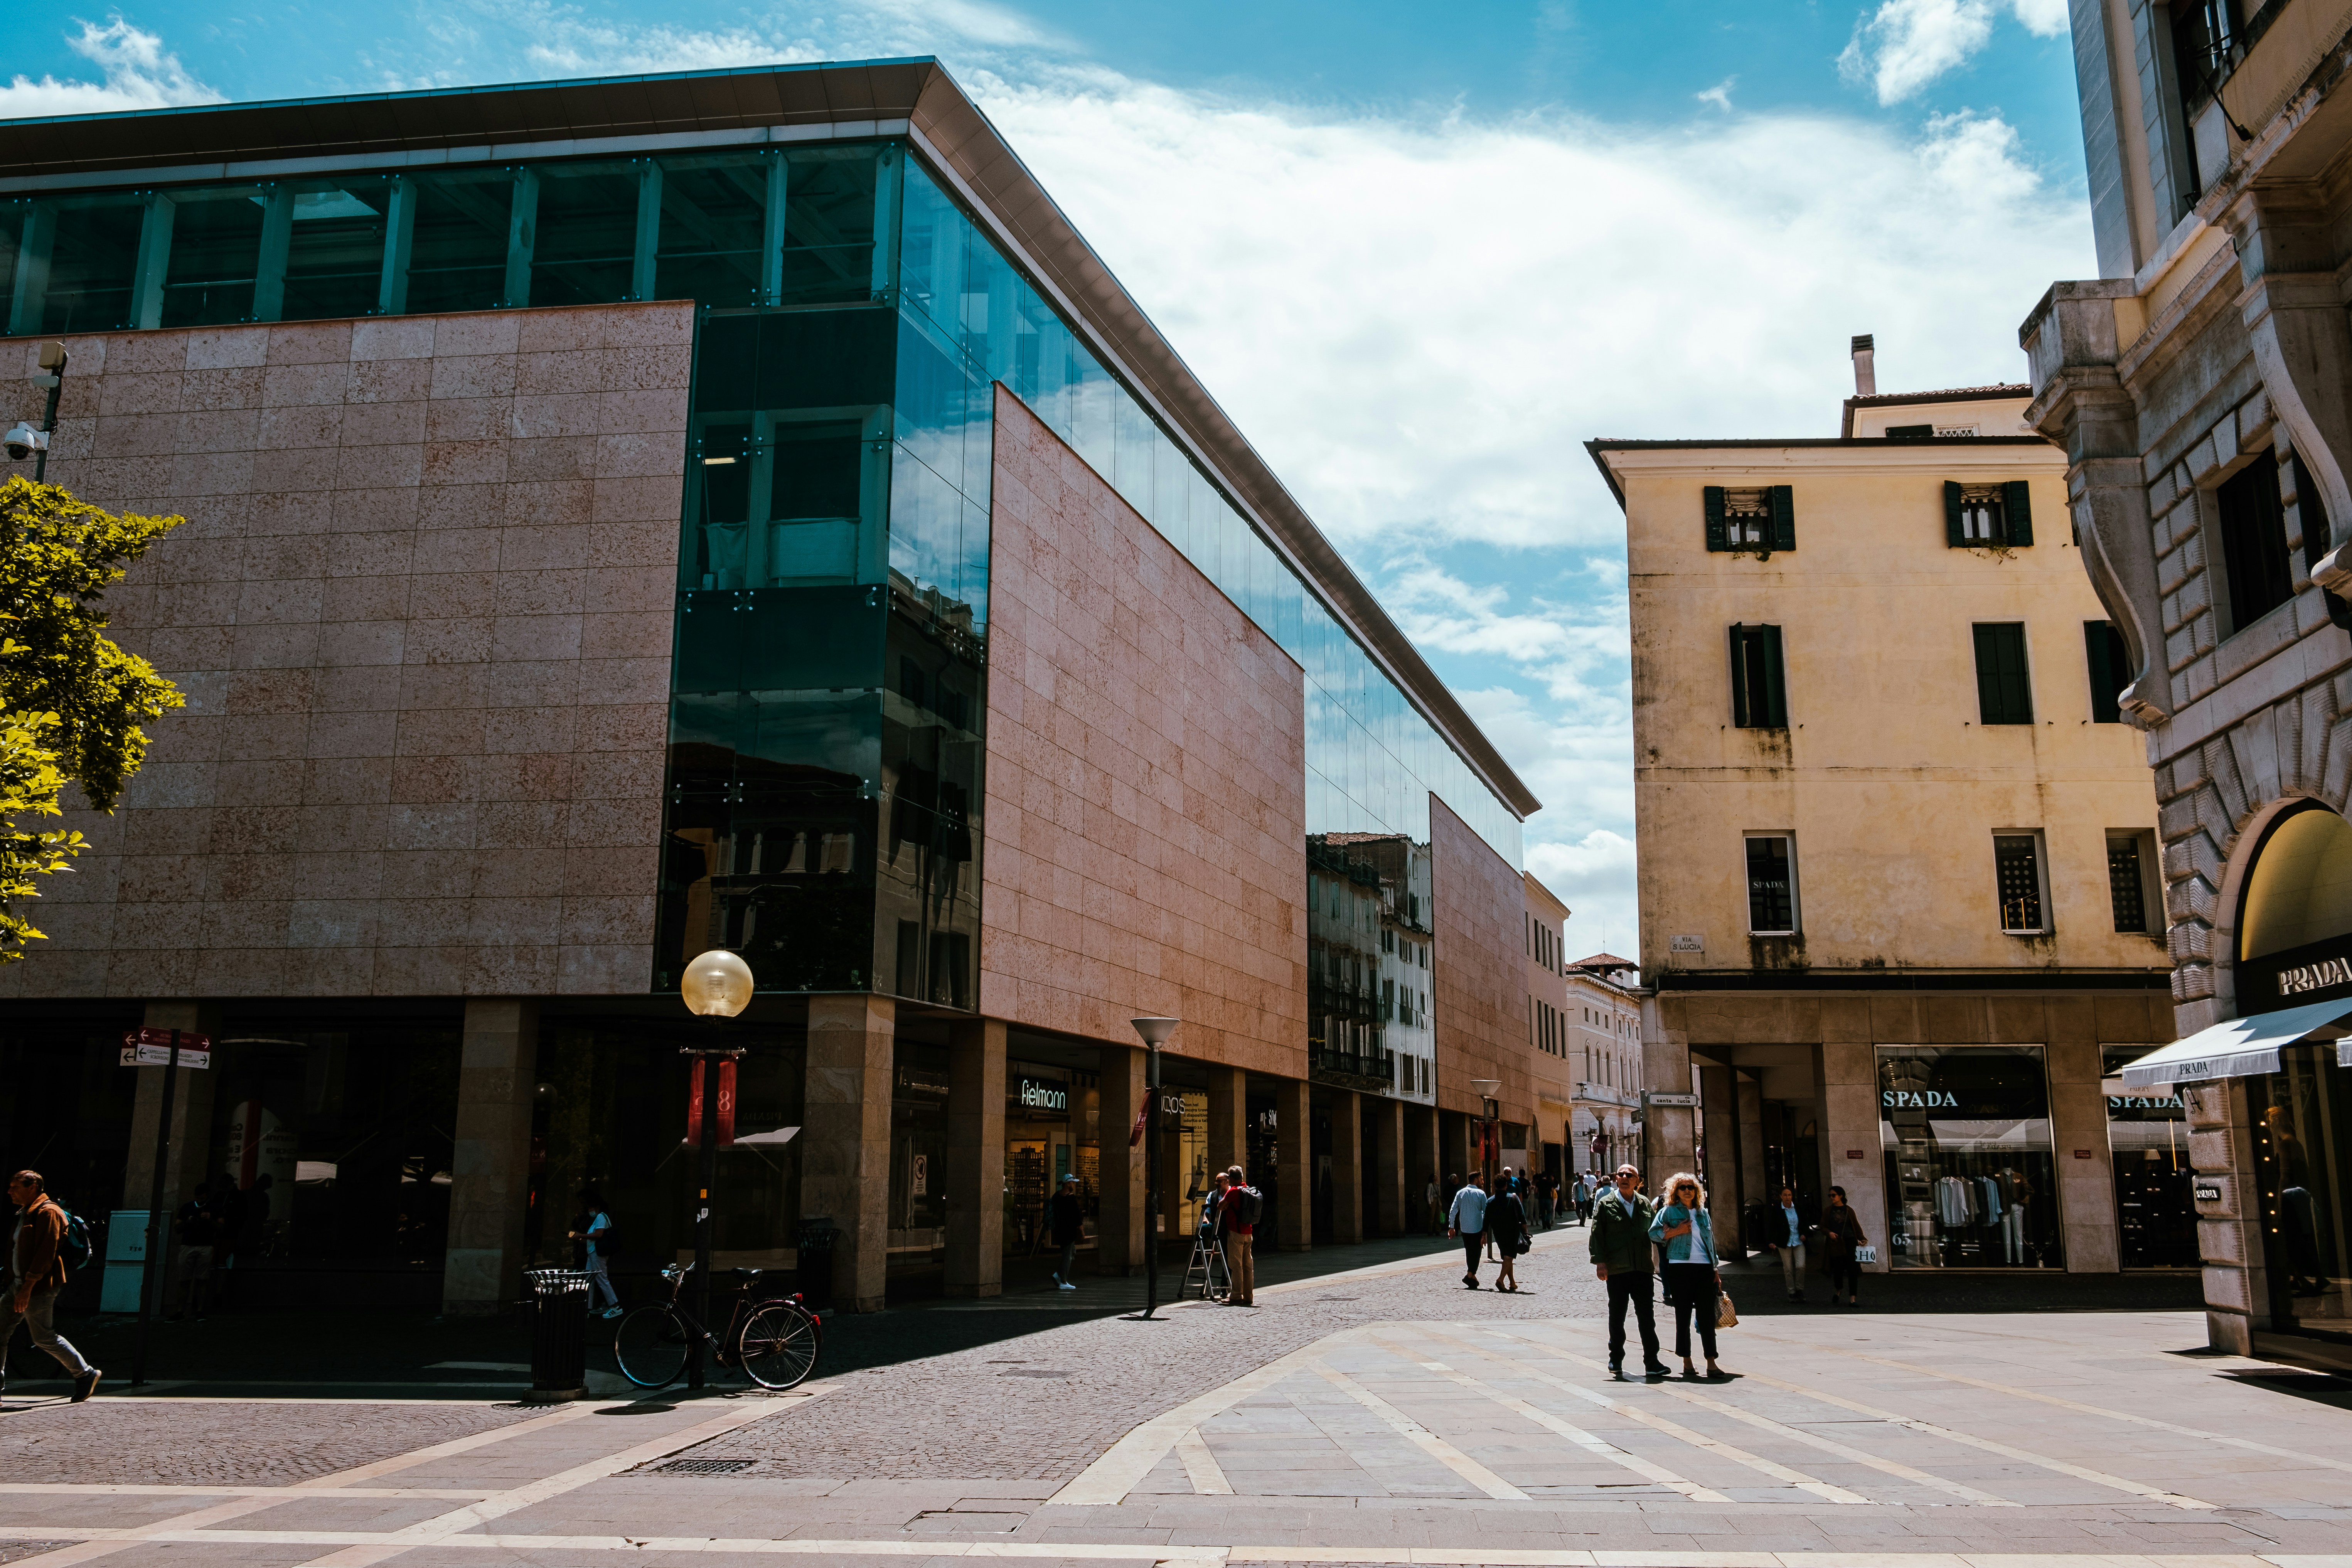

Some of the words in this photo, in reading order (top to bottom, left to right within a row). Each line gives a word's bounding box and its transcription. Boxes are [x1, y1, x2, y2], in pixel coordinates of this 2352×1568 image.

[2277, 958, 2352, 995] PRADA
[2180, 1061, 2208, 1075] PRADA
[1022, 1080, 1065, 1109] fielmann
[1884, 1091, 1958, 1107] SPADA
[2110, 1093, 2185, 1108] SPADA
[1161, 1095, 1185, 1115] IQOS
[2196, 1190, 2218, 1198] PRADA
